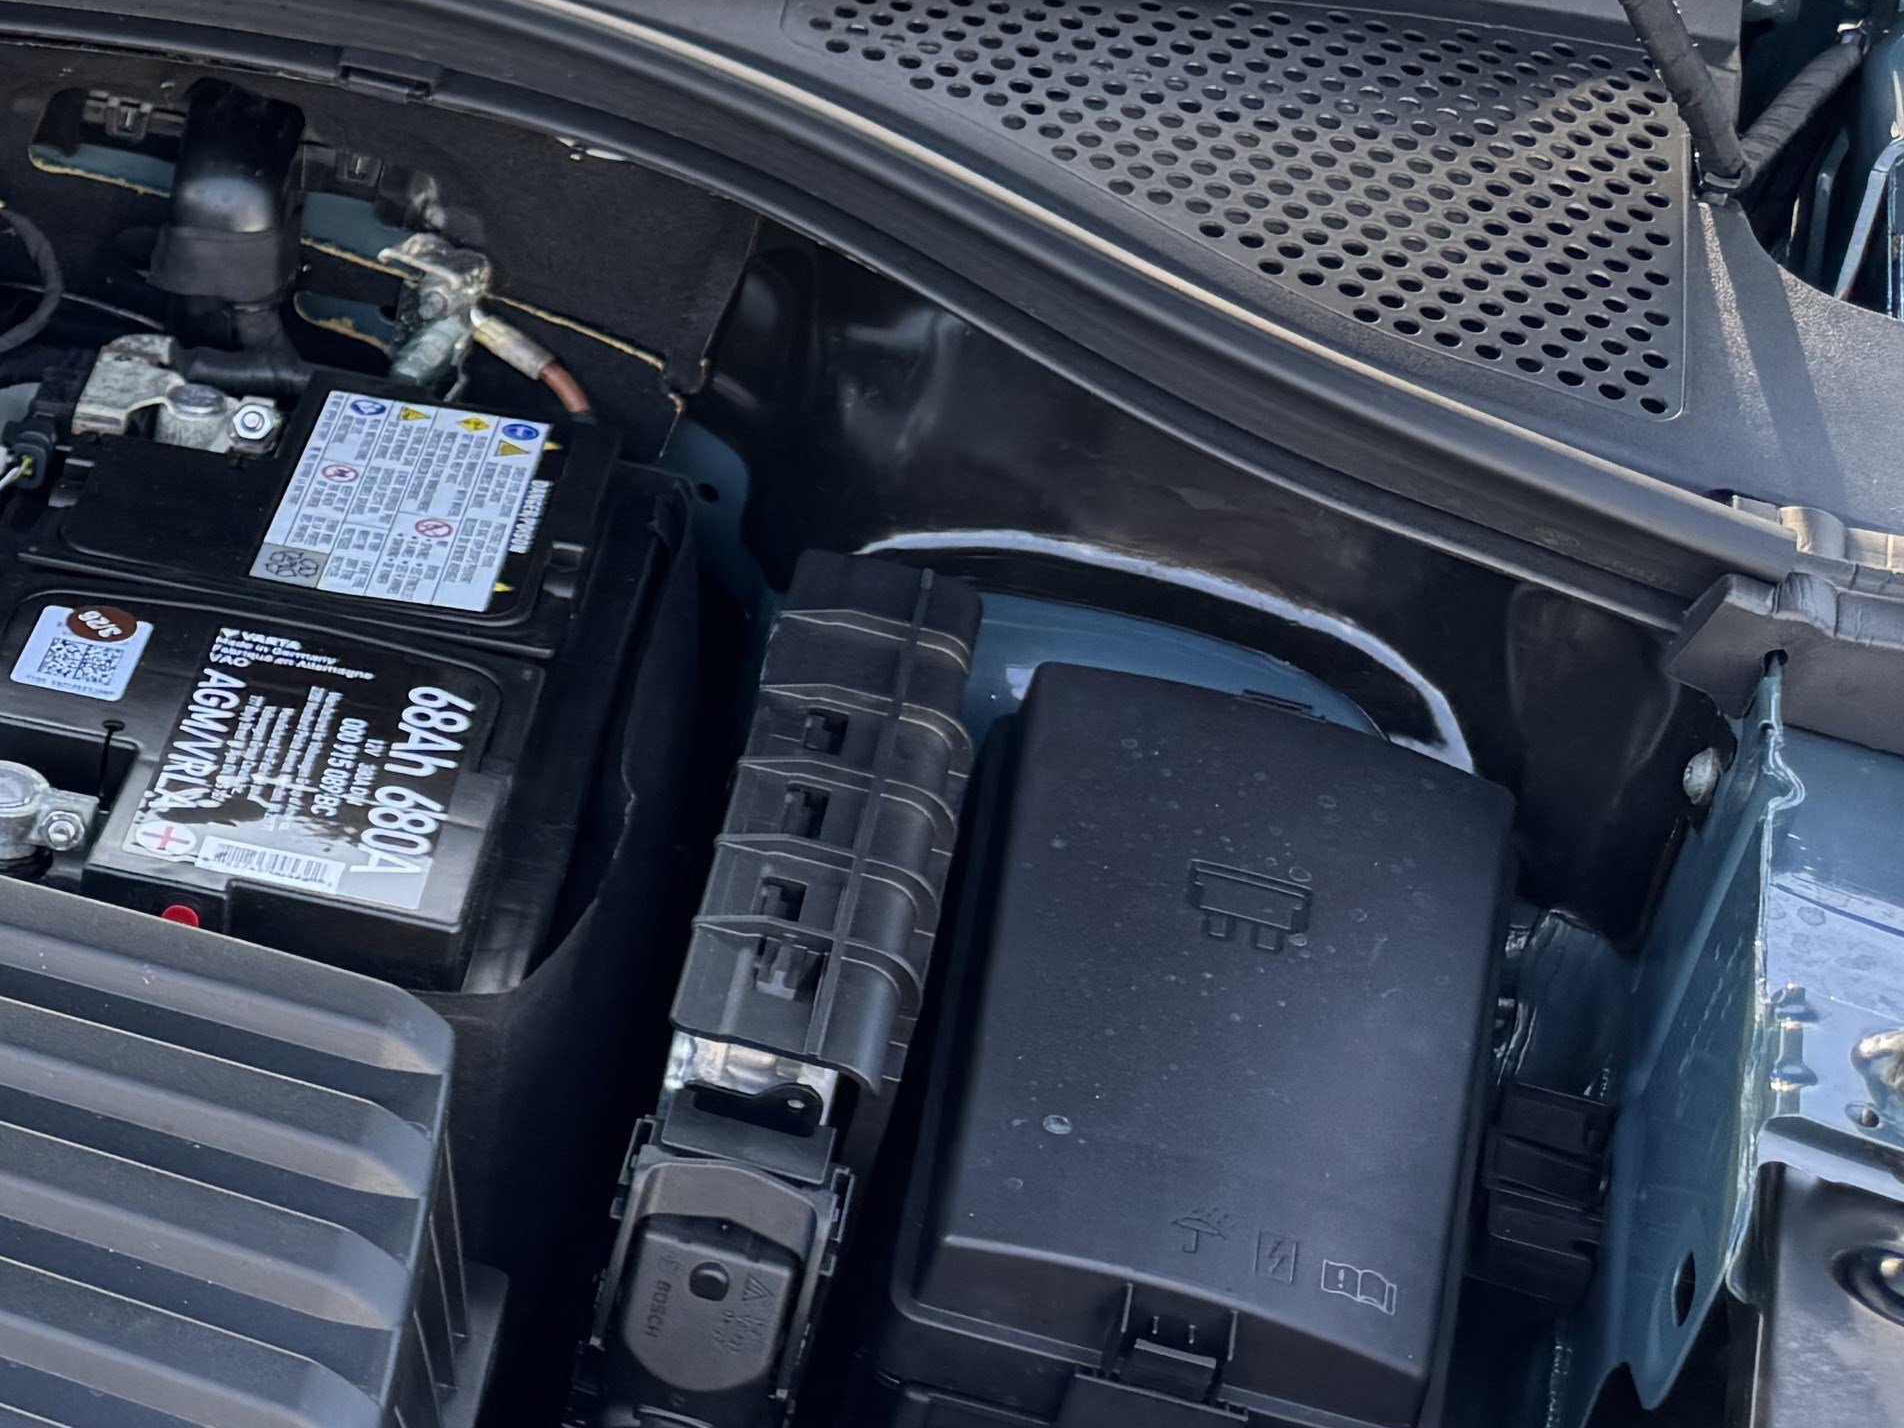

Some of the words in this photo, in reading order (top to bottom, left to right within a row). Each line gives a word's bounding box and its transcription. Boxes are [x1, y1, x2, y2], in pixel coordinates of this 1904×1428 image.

[153, 667, 247, 813] AGM/VRLA
[383, 684, 476, 780] 68Ah
[347, 784, 448, 877] 680A
[643, 1280, 672, 1339] BOSCH
